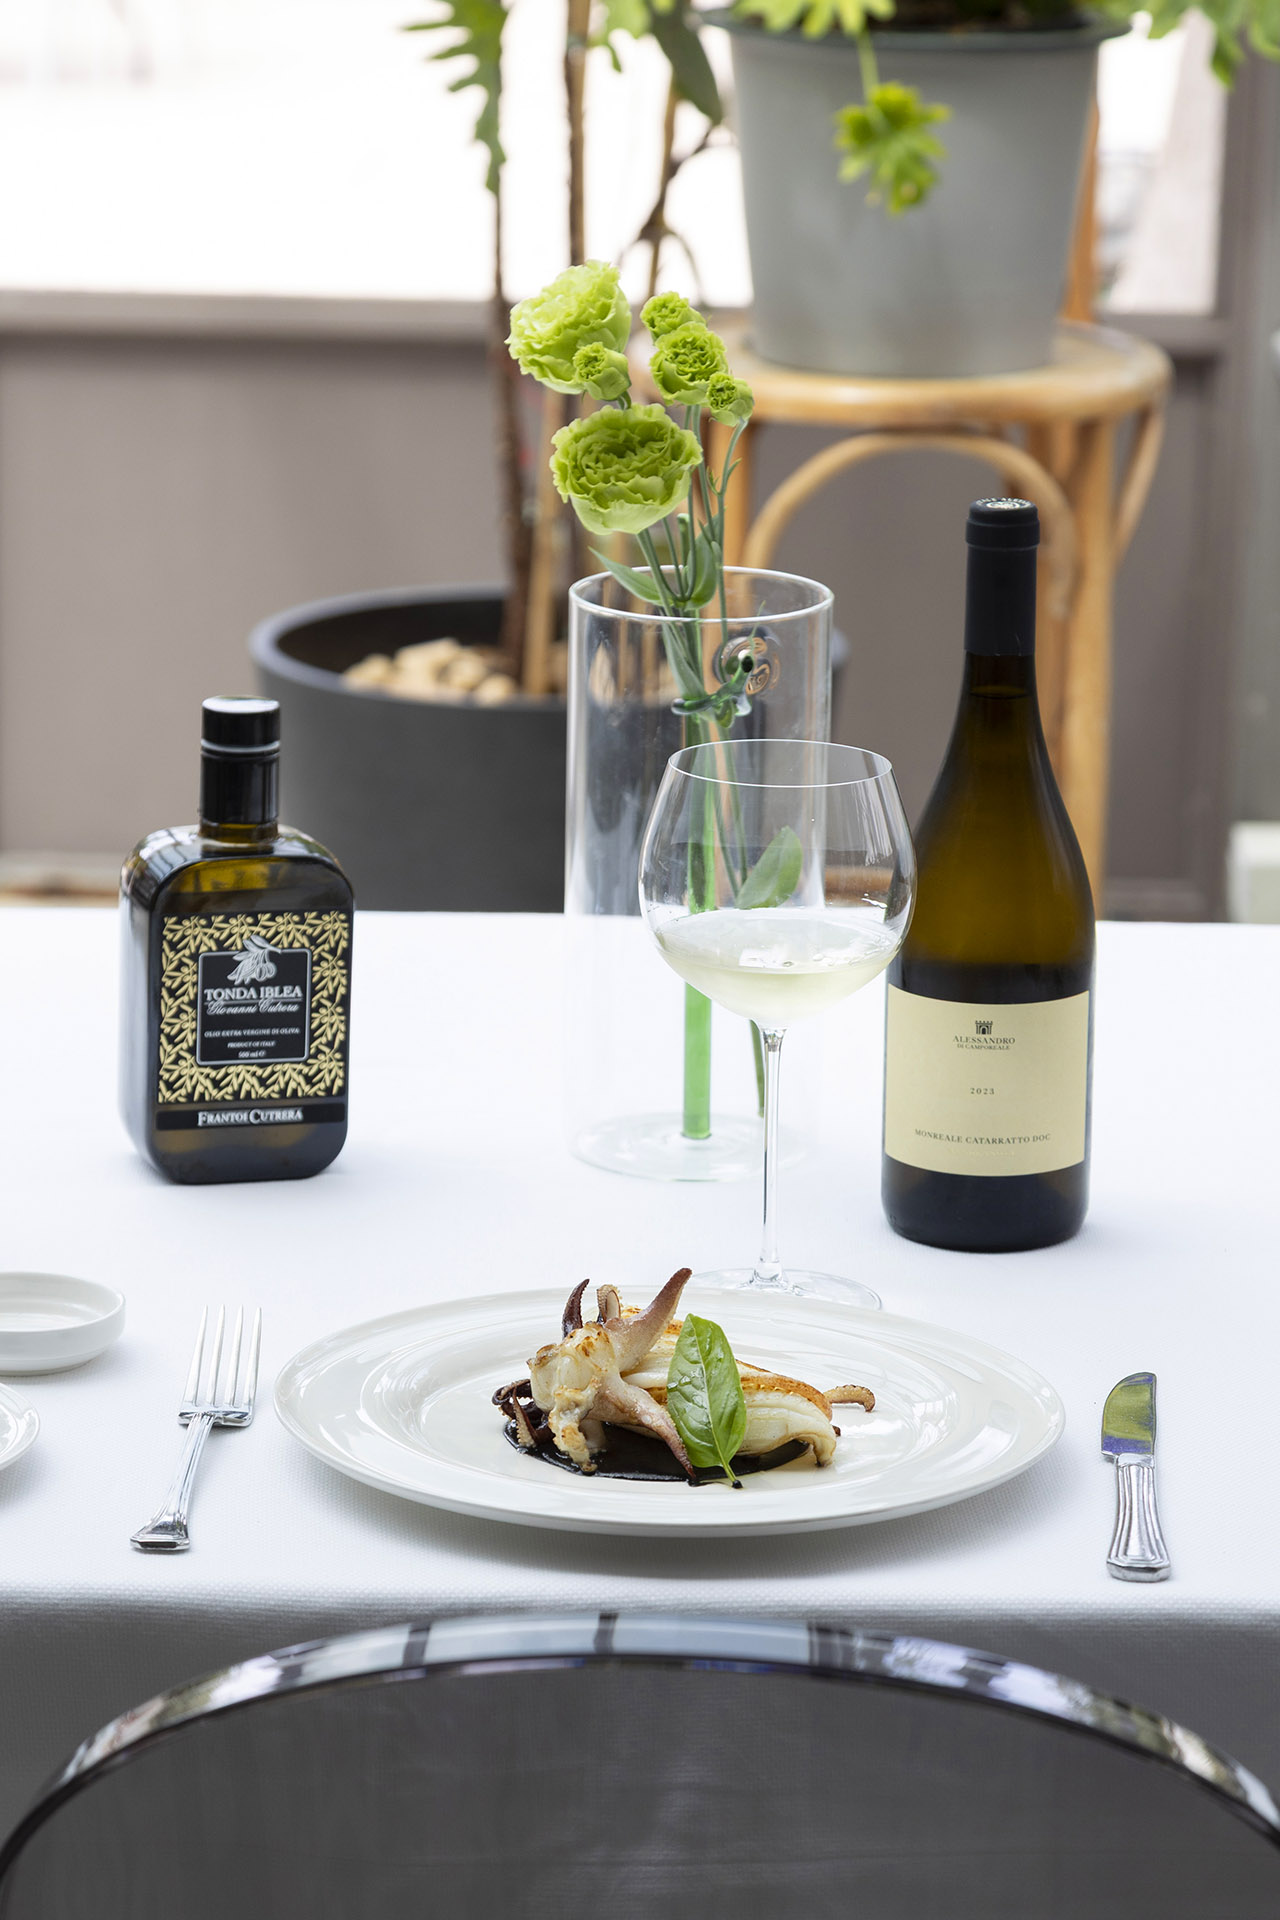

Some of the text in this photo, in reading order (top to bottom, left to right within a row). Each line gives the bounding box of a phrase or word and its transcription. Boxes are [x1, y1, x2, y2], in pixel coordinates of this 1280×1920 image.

[204, 985, 303, 1001] TONDA IBLEA
[206, 1000, 258, 1015] Giovanni
[204, 1030, 220, 1038] OLIO
[221, 1029, 241, 1037] EXTRA
[243, 1028, 270, 1036] VERGINE
[280, 1027, 300, 1035] OLIVA
[953, 1035, 1016, 1045] ALESSANDRO
[970, 1087, 995, 1095] 2023
[198, 1107, 303, 1127] FRANTOI CUTRERA
[914, 1128, 1051, 1145] MONREALE CATARRATTO DOC
